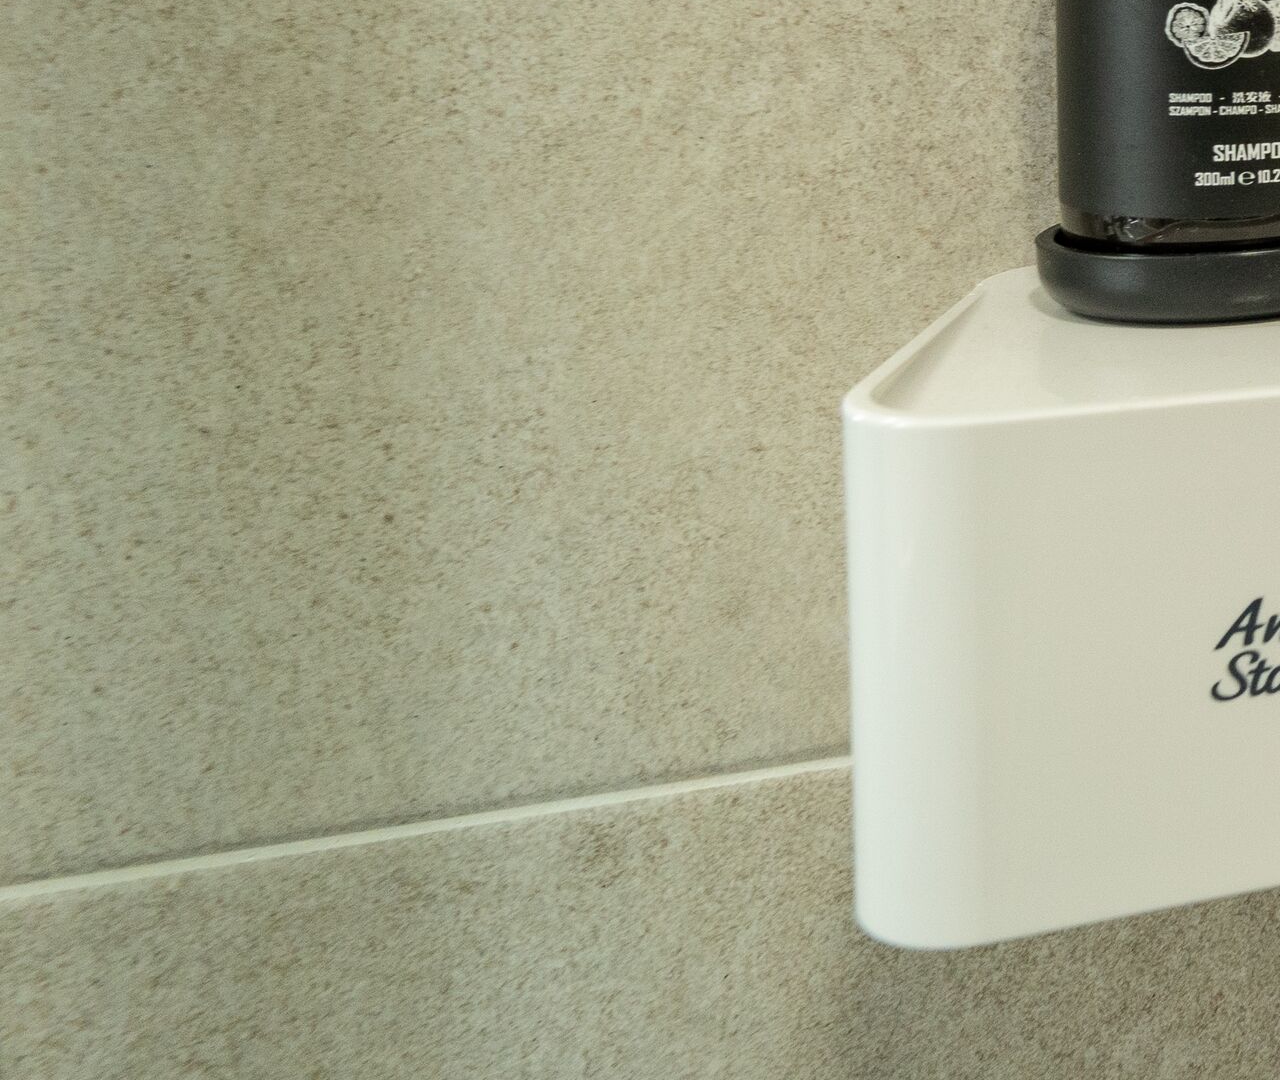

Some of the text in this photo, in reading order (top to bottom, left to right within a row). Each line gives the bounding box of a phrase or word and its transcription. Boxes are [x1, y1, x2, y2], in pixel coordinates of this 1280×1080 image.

[1169, 93, 1213, 103] SHAMPOO
[1169, 106, 1211, 116] SZAMPON
[1194, 171, 1235, 186] 300ml
